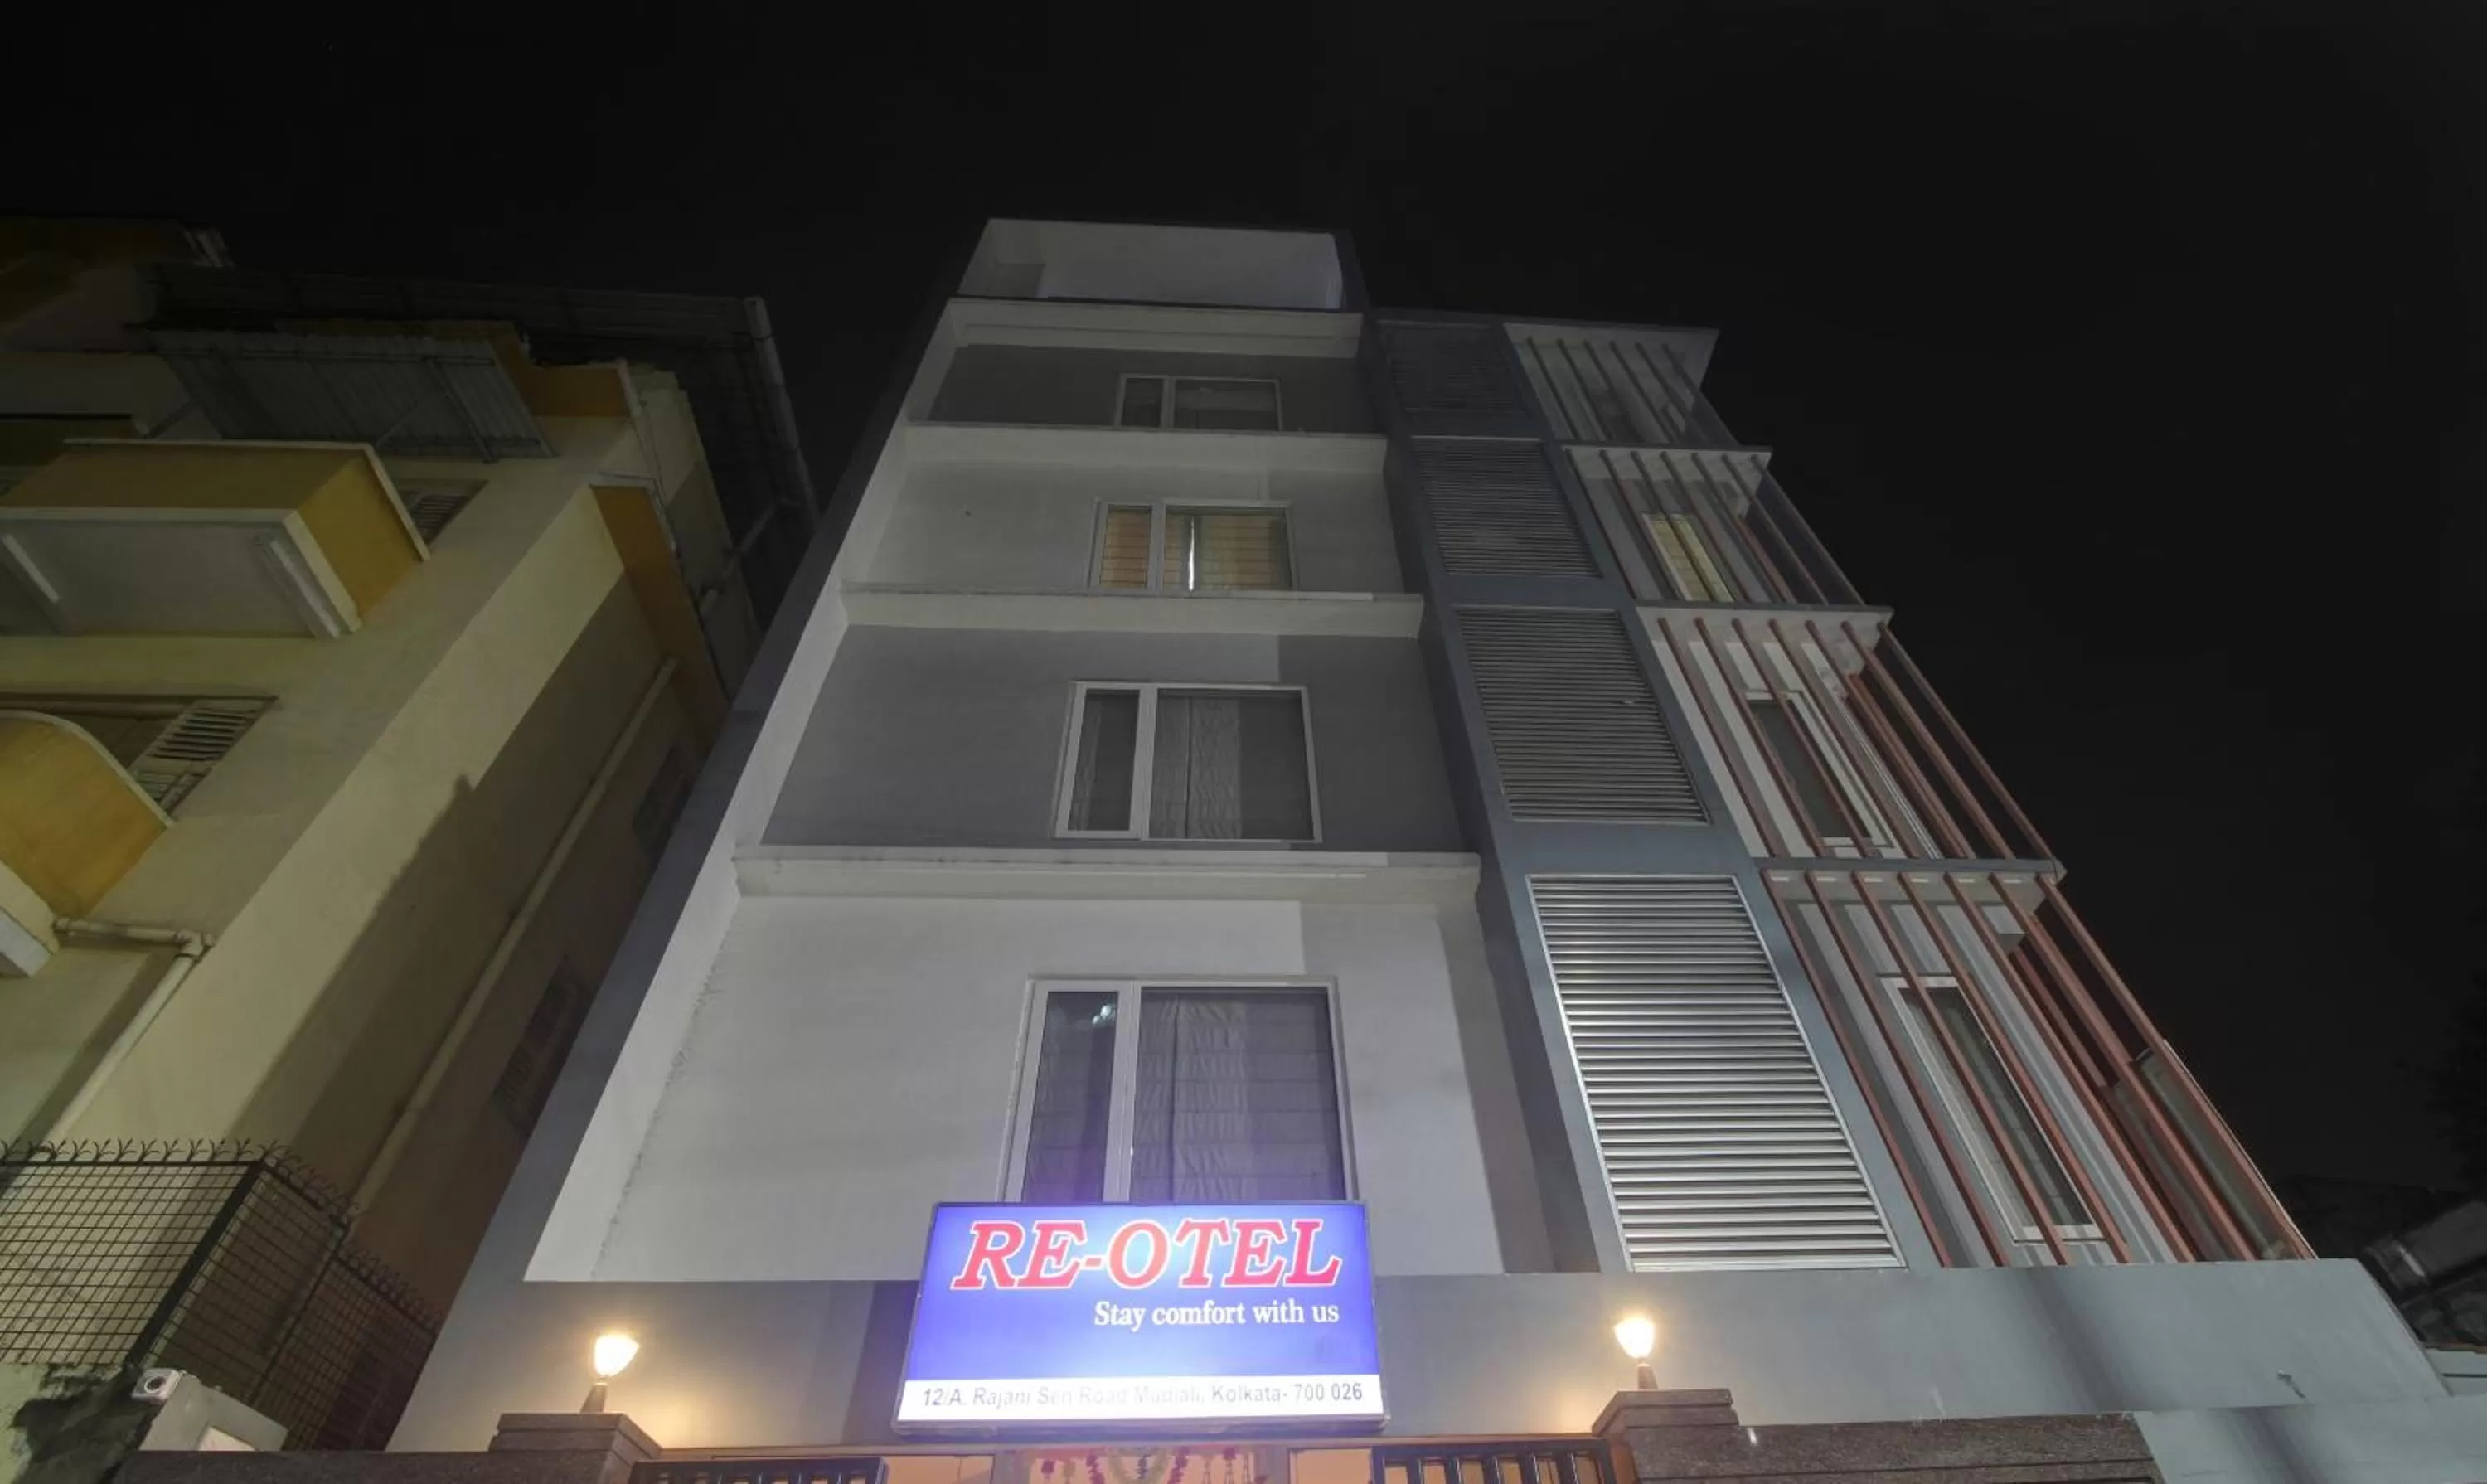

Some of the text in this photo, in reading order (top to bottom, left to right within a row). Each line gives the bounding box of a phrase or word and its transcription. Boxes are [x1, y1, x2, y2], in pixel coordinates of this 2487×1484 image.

[951, 1218, 1342, 1290] RE-OTEL
[1094, 1298, 1340, 1332] Stay comfort with us
[1037, 1385, 1072, 1406] Sen
[1079, 1385, 1128, 1405] Road
[1293, 1382, 1325, 1402] 700
[1331, 1382, 1364, 1402] 026
